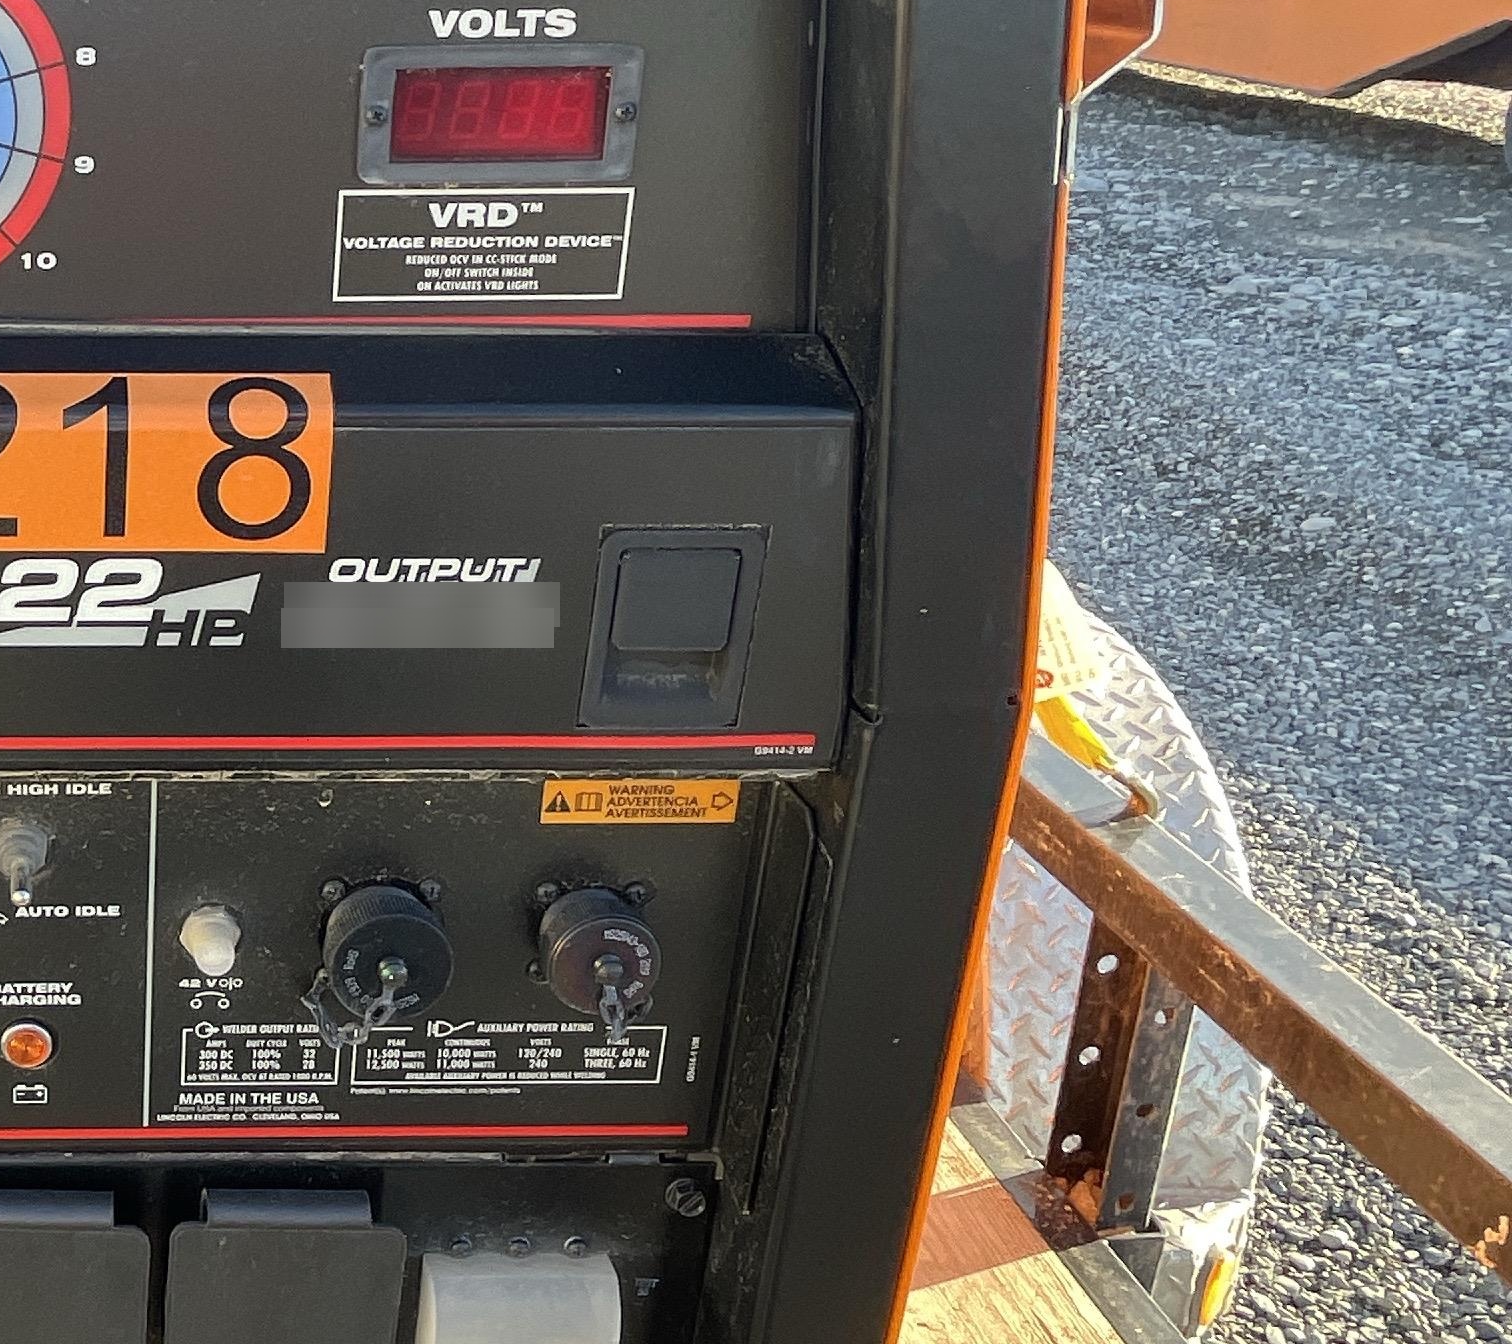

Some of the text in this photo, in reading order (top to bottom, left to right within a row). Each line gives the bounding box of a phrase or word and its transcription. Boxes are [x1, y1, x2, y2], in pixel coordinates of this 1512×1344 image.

[428, 8, 577, 40] VOLTS
[74, 47, 97, 67] 8
[74, 155, 95, 174] 9
[343, 236, 425, 250] VOLTAGE
[431, 235, 539, 249] REDUCTION
[20, 252, 57, 270] 10
[405, 254, 448, 265] REDUCED
[464, 268, 500, 278] SWITCH
[502, 267, 534, 278] INSIDE
[417, 280, 539, 291] ON ACTIVATES VRD LIGHTS
[7, 782, 113, 796] HIGH IDLE
[609, 785, 675, 796] WARNING
[607, 796, 699, 807] ADVERTENCIA
[605, 807, 708, 819] AVERTISSEMENT
[15, 904, 121, 918] AUTO IDLE
[222, 1024, 294, 1034] WELDER OUTPUT
[477, 1023, 524, 1033] AUXILIARY
[526, 1022, 559, 1032] POWER
[198, 1050, 234, 1060] 300 DC
[179, 1092, 319, 1105] MADE IN THE USA
